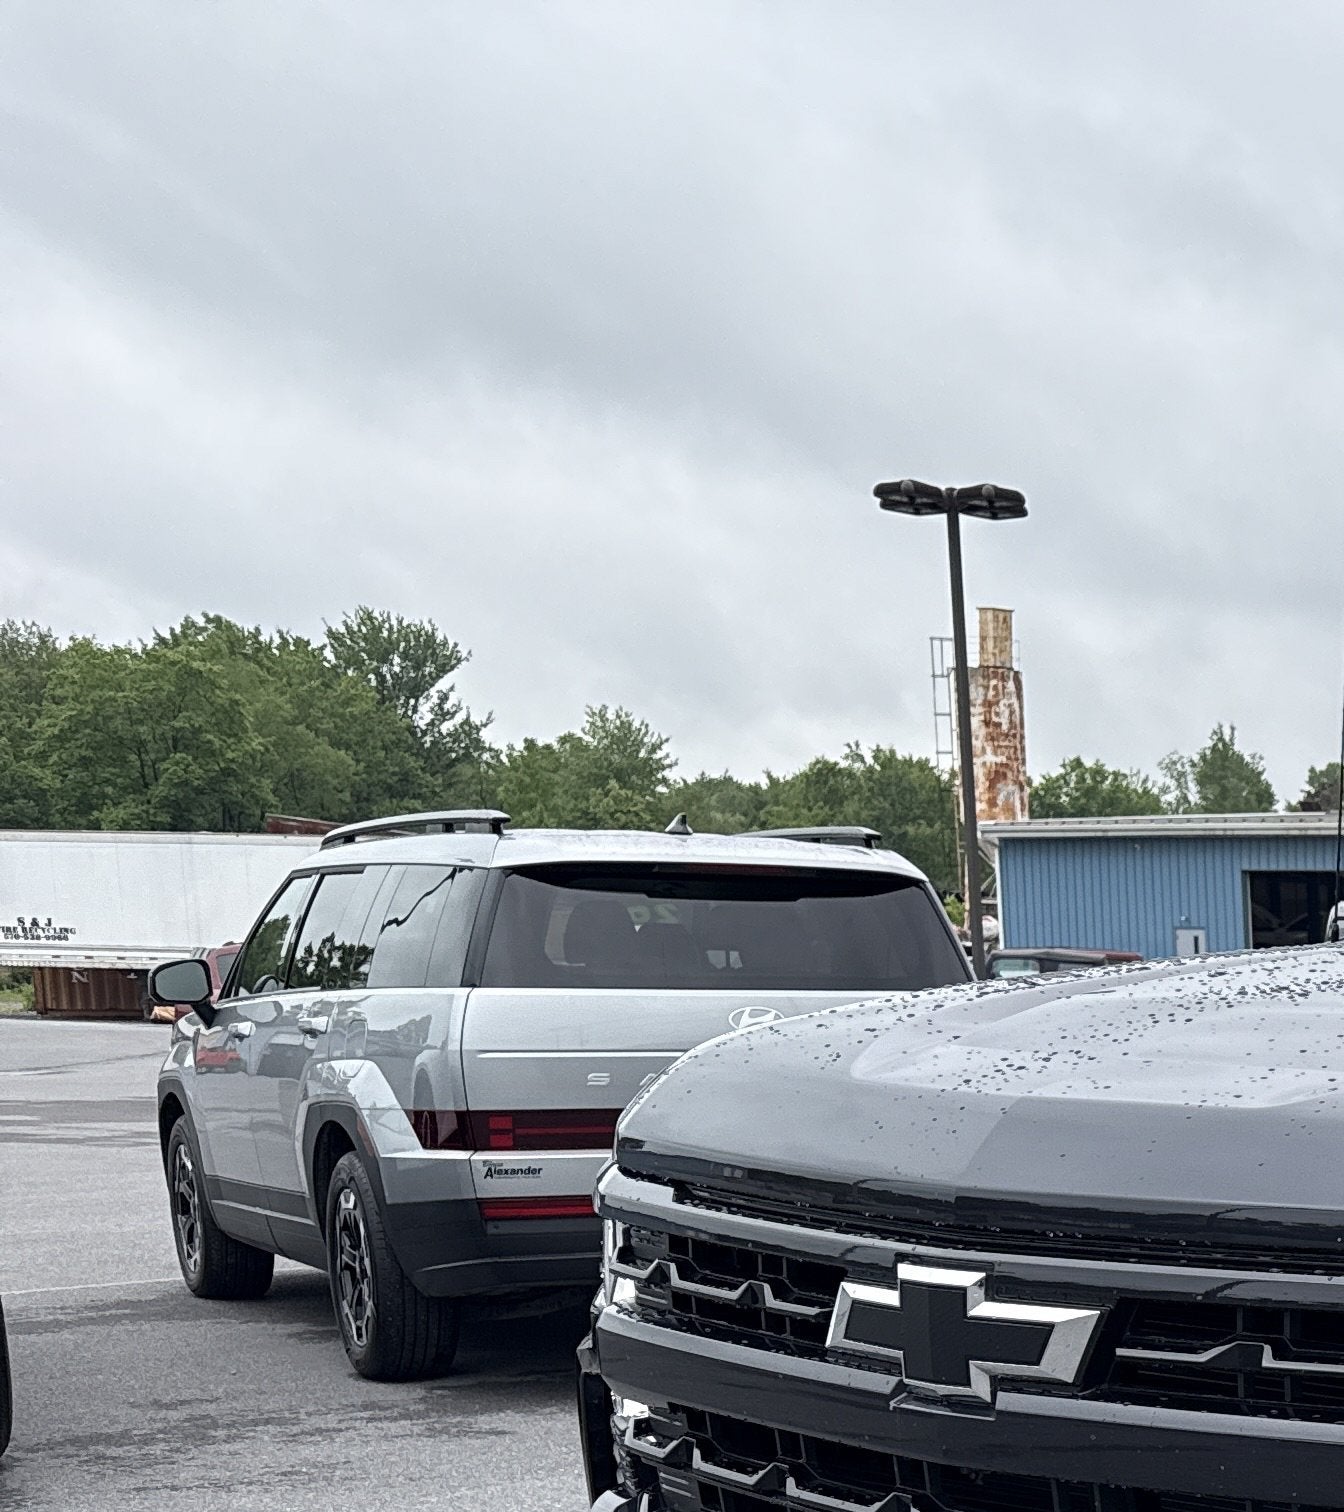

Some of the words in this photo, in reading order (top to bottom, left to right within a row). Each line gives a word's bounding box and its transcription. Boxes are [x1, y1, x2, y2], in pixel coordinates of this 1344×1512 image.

[17, 917, 25, 927] S
[31, 917, 39, 927] &
[45, 918, 52, 927] J
[22, 926, 76, 935] RECYCLING
[484, 1166, 543, 1179] Alexander
